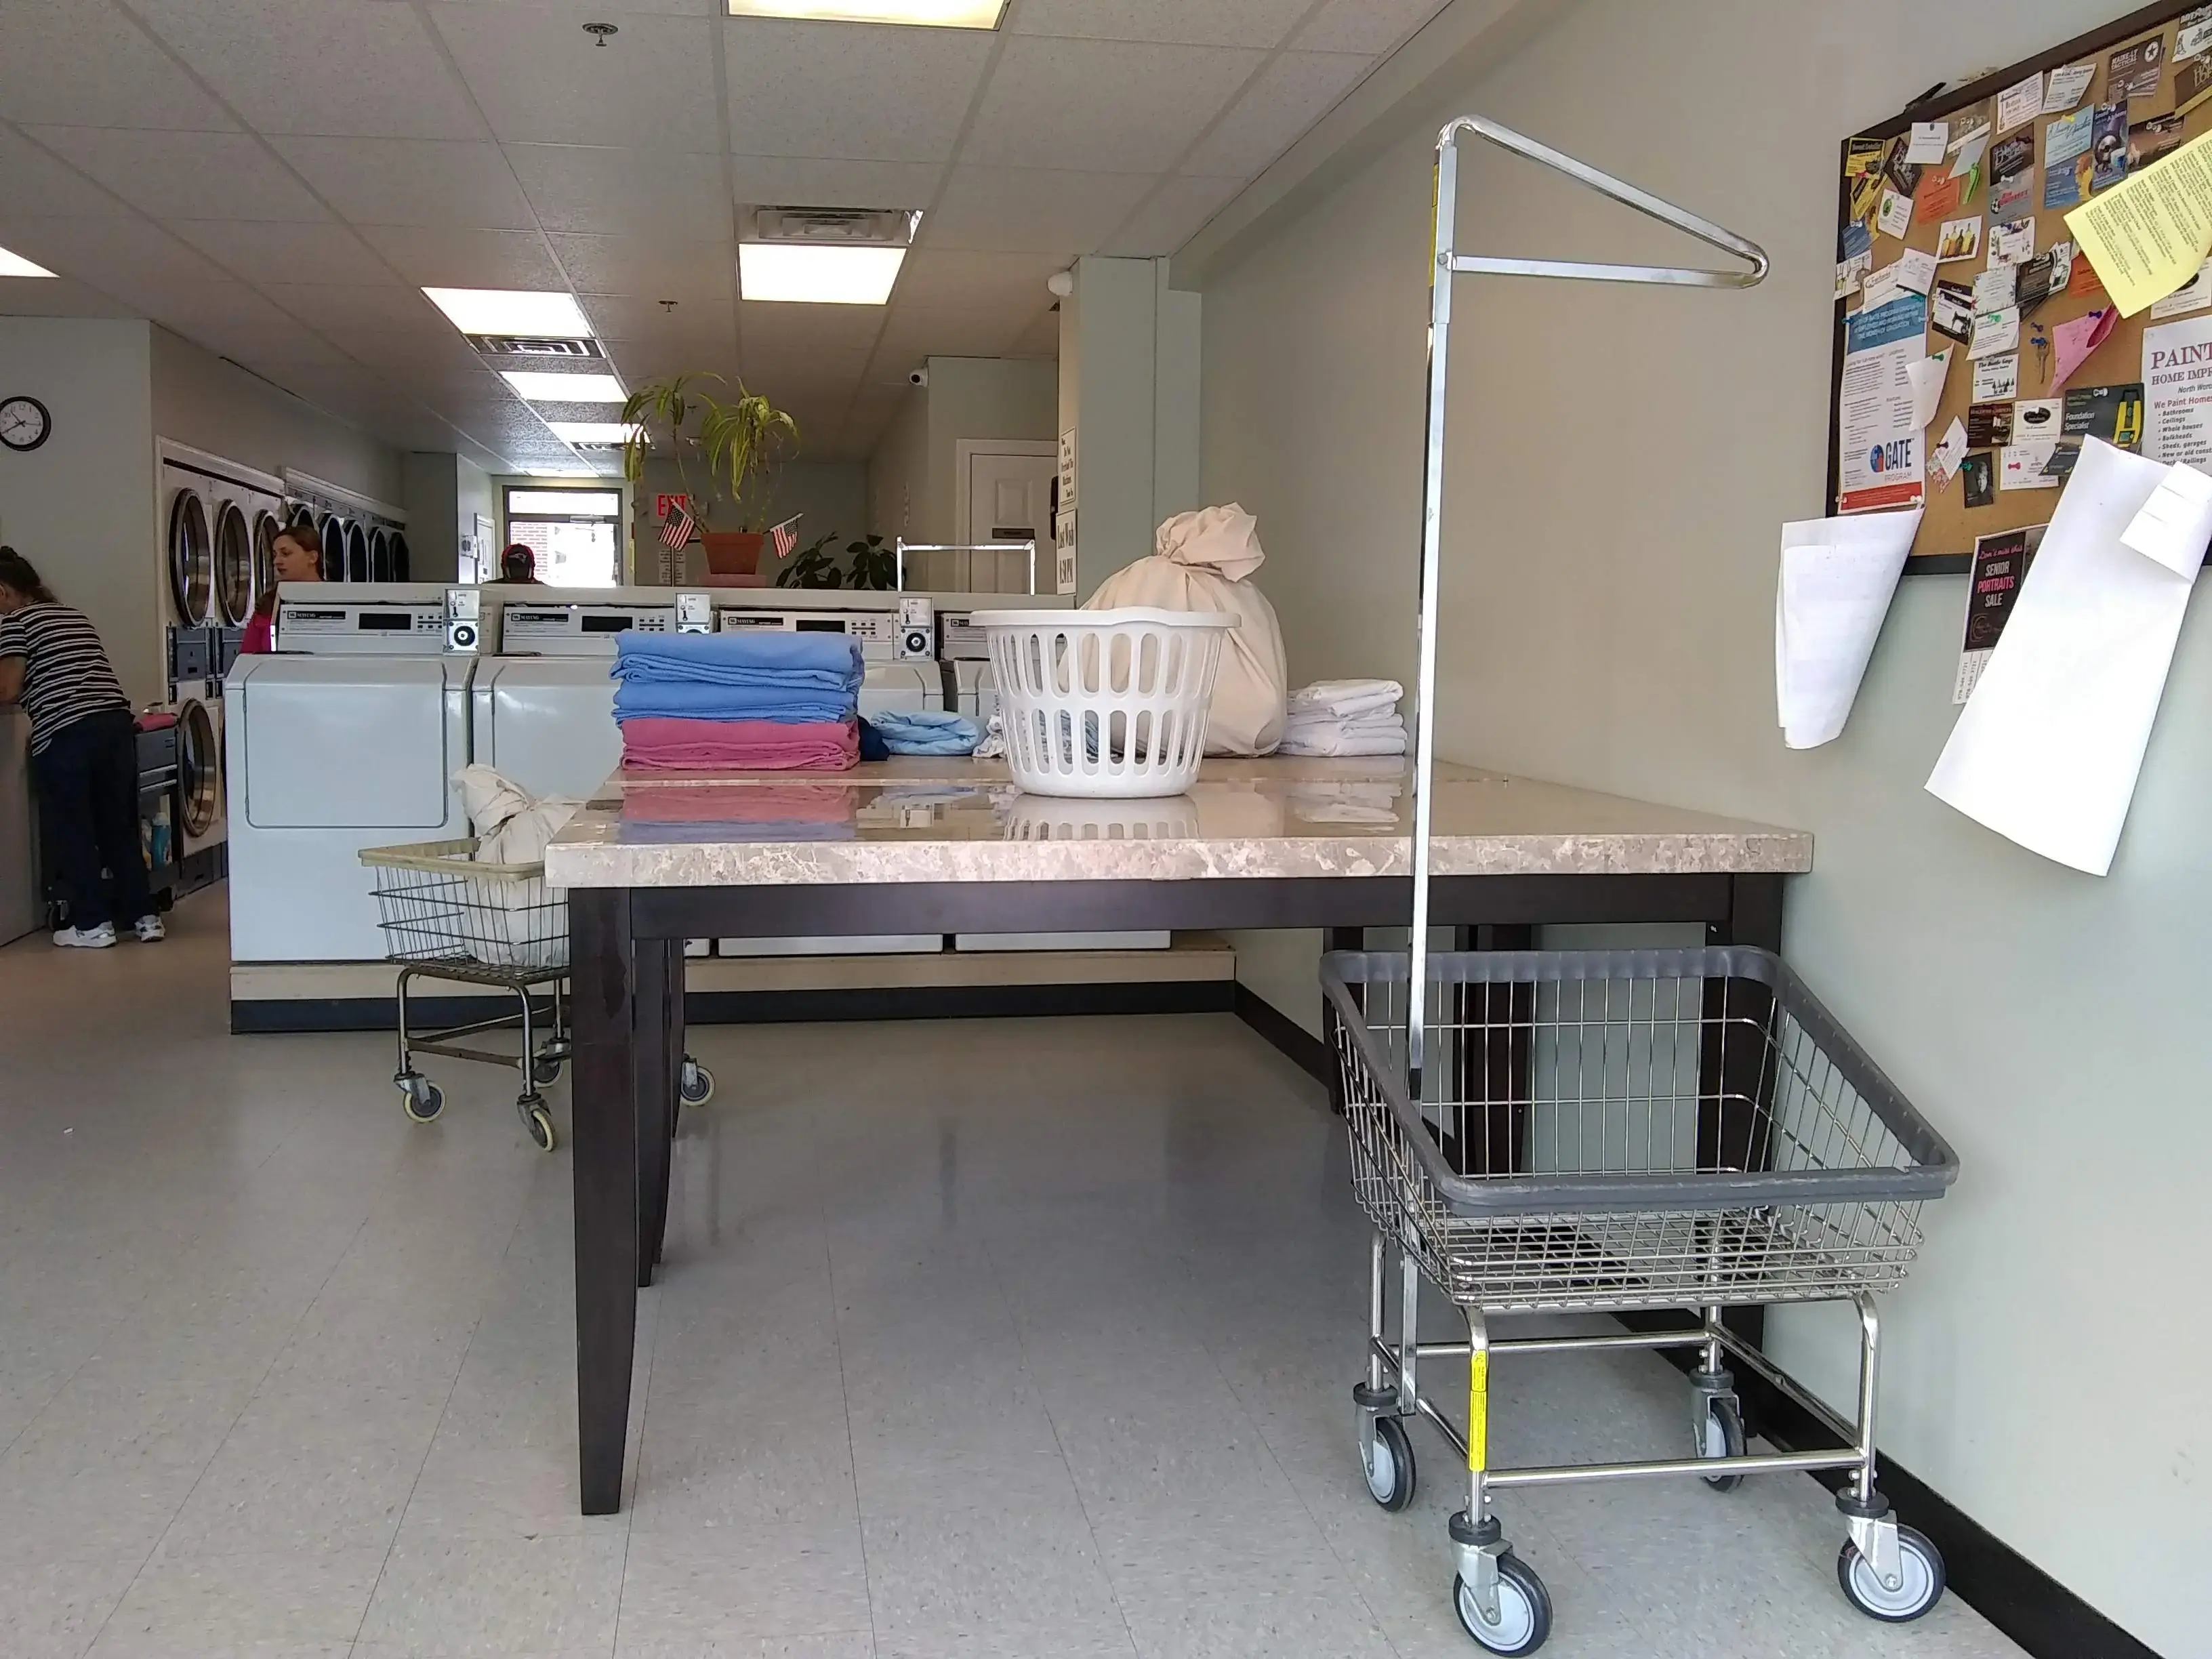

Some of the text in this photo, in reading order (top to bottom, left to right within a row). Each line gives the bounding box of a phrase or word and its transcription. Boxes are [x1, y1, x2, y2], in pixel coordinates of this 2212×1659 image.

[2152, 372, 2185, 386] HOME
[2177, 385, 2196, 394] North
[2154, 401, 2166, 409] We
[2167, 398, 2186, 407] Paint
[2066, 411, 2095, 421] Foundation
[2162, 407, 2194, 417] Bathrooms
[2064, 422, 2090, 432] Specialist
[2162, 432, 2193, 441] Bulkheads
[2183, 440, 2207, 448] garages
[1885, 438, 1912, 471] GATE
[1985, 560, 2010, 577] SENIOR
[1977, 575, 2015, 594] PORTRAITS
[1984, 592, 2003, 608] SALE
